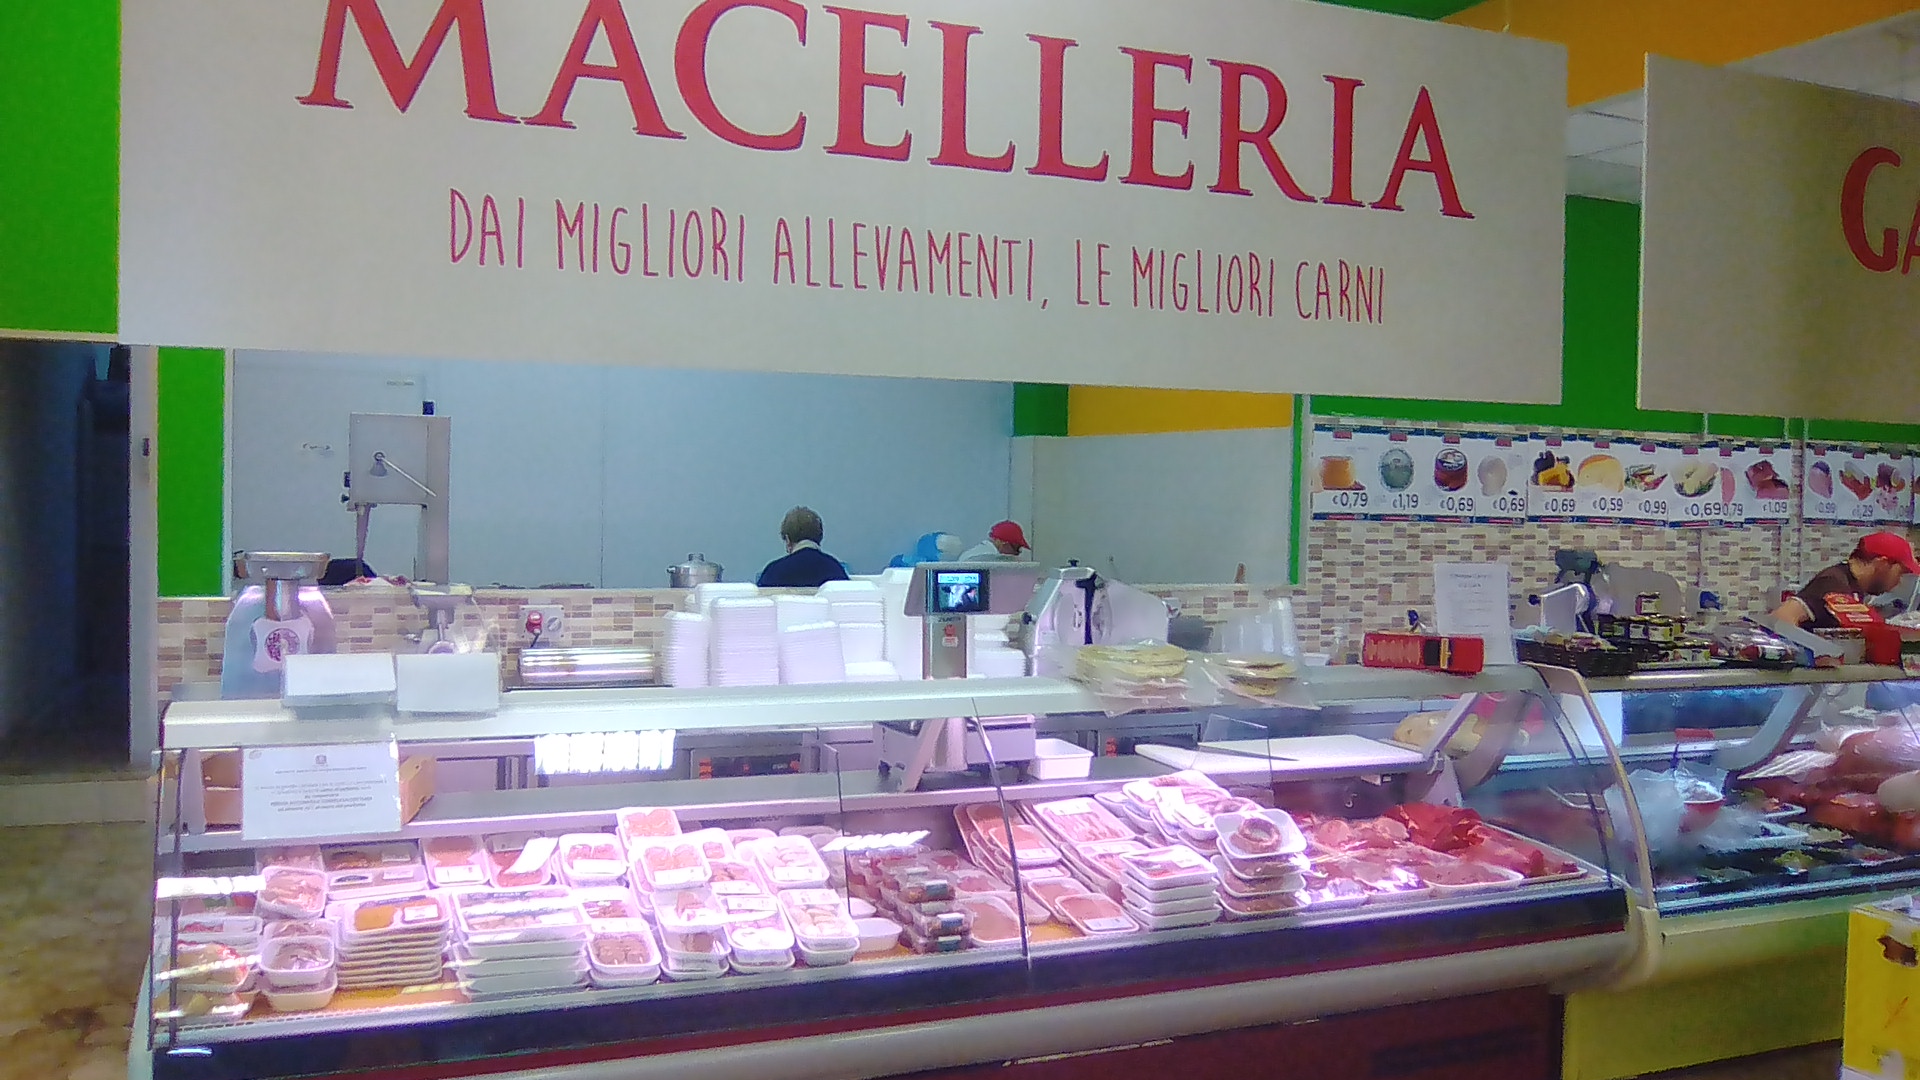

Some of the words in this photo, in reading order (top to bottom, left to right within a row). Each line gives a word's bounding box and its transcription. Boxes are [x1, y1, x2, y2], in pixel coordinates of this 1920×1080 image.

[297, 0, 1475, 219] MACELLERIA
[449, 188, 526, 270] DAI
[555, 199, 746, 283] MIGLIORI
[773, 217, 1049, 311] ALLEVAMENTI,
[1076, 238, 1111, 309] LE
[1131, 246, 1275, 319] MIGLIORI
[1294, 260, 1386, 325] CARNI
[1332, 492, 1368, 508] €0,79
[1392, 494, 1419, 510] €1,19
[1440, 497, 1474, 513] €0,69
[1493, 497, 1525, 513] €0,69
[1544, 498, 1576, 513] €0,69
[1592, 497, 1624, 513] €0,59
[1638, 500, 1667, 515] €0,99
[1684, 502, 1721, 517] €0,69
